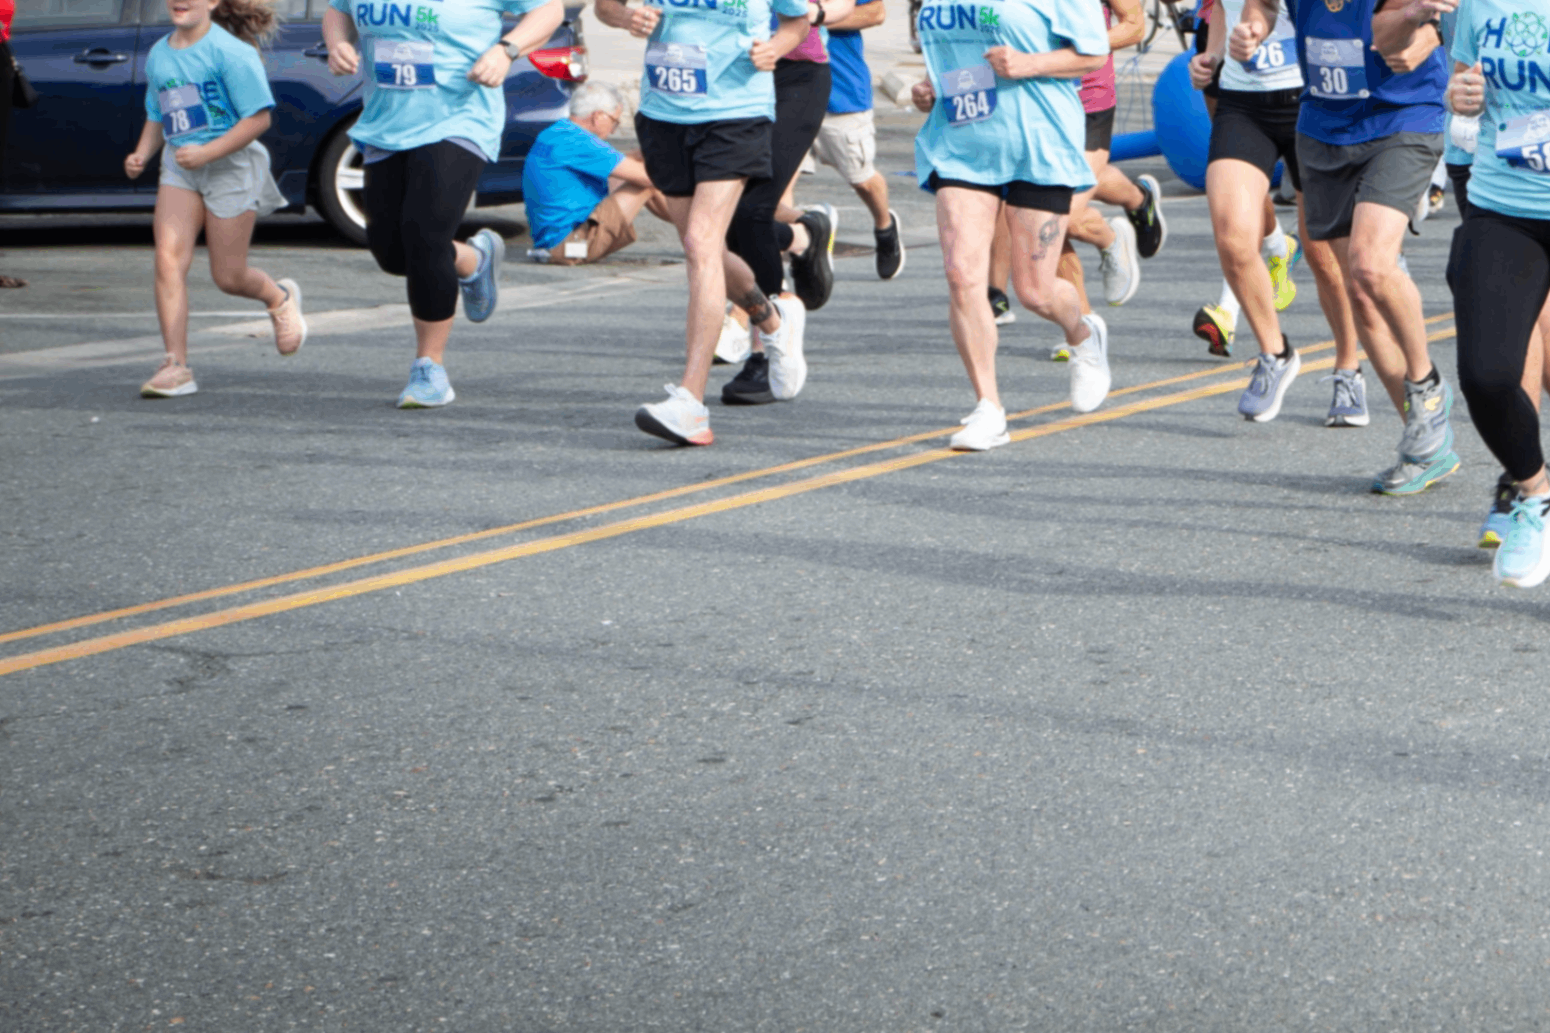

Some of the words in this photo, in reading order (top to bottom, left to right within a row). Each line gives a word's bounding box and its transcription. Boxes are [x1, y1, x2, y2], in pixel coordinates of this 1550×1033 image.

[357, 2, 412, 27] RUN
[722, 7, 748, 18] 2025
[919, 4, 978, 32] RUN
[1255, 42, 1285, 69] 26
[391, 63, 417, 86] 79
[655, 66, 697, 93] 265
[1319, 67, 1348, 94] 30
[953, 91, 990, 121] 264
[169, 109, 190, 133] 78
